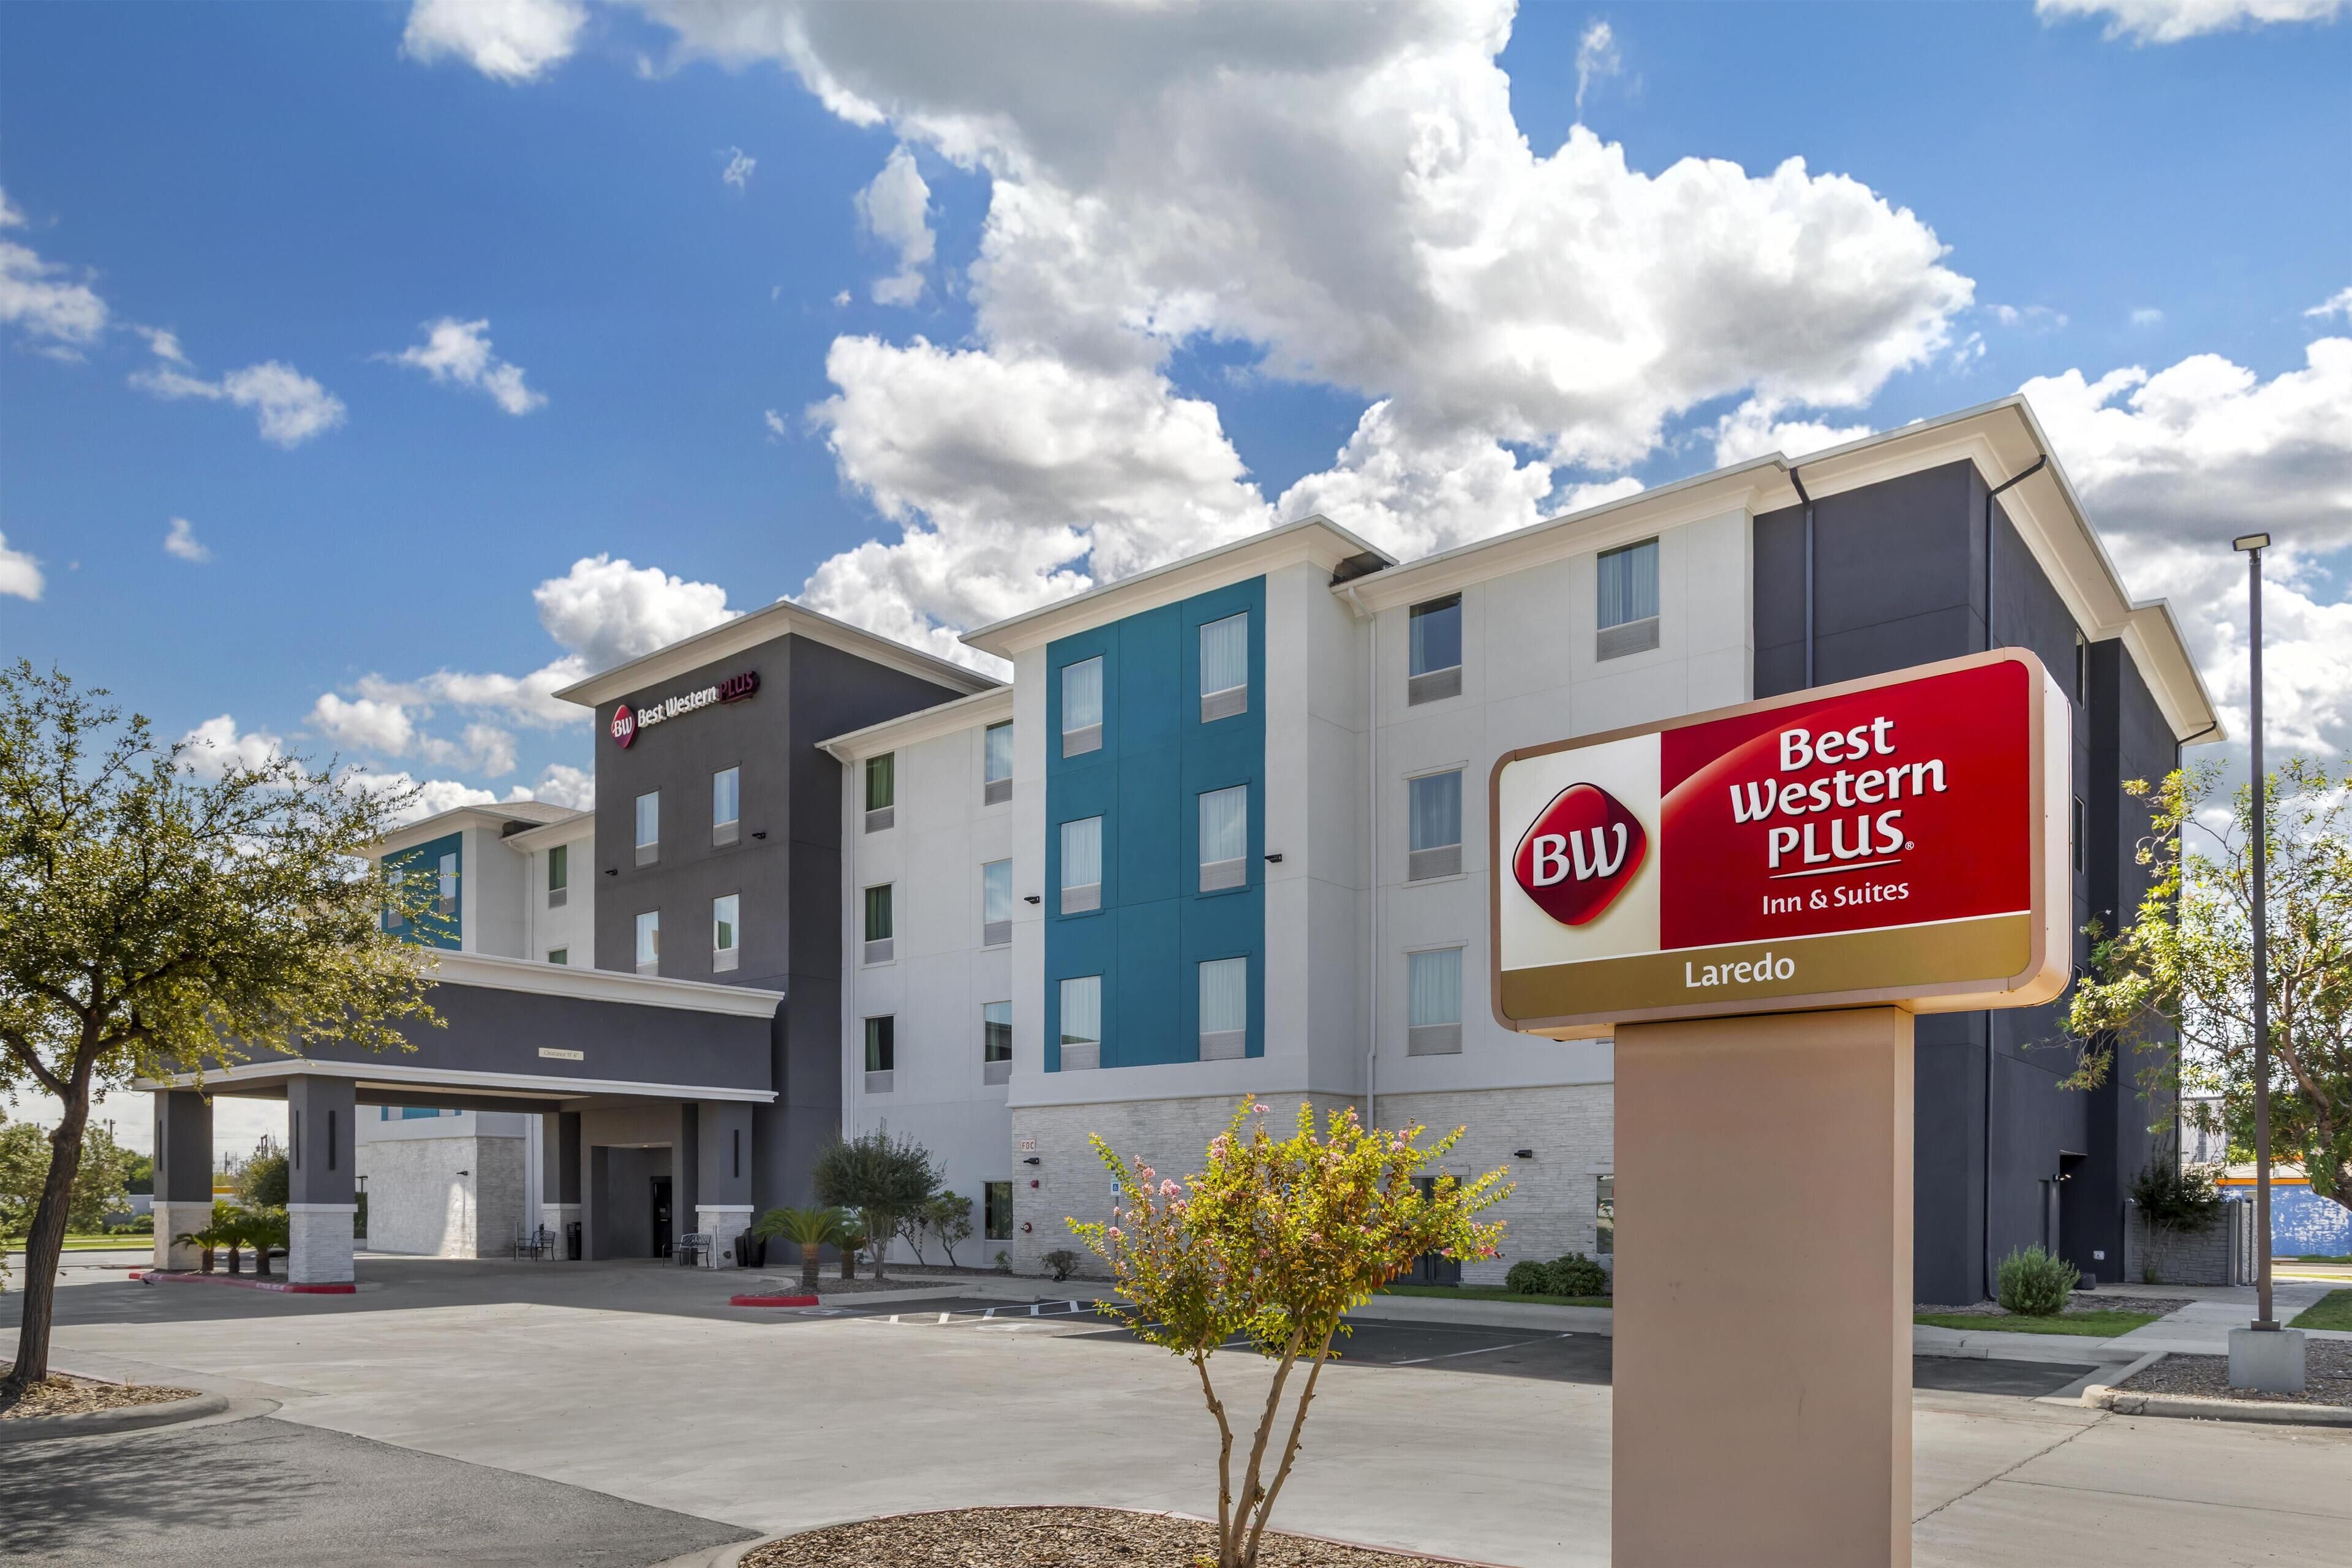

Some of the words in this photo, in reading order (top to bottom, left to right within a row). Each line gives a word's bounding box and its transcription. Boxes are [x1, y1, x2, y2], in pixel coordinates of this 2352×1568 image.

[613, 715, 632, 737] BW
[638, 703, 666, 728] Best
[665, 685, 719, 718] Western
[1780, 716, 1896, 772] Best
[1729, 759, 1948, 823] Western
[1532, 821, 1628, 887] BW
[1763, 895, 1803, 915] Inn
[1809, 889, 1828, 910] &
[1833, 882, 1910, 907] Suites
[1684, 952, 1796, 988] Laredo
